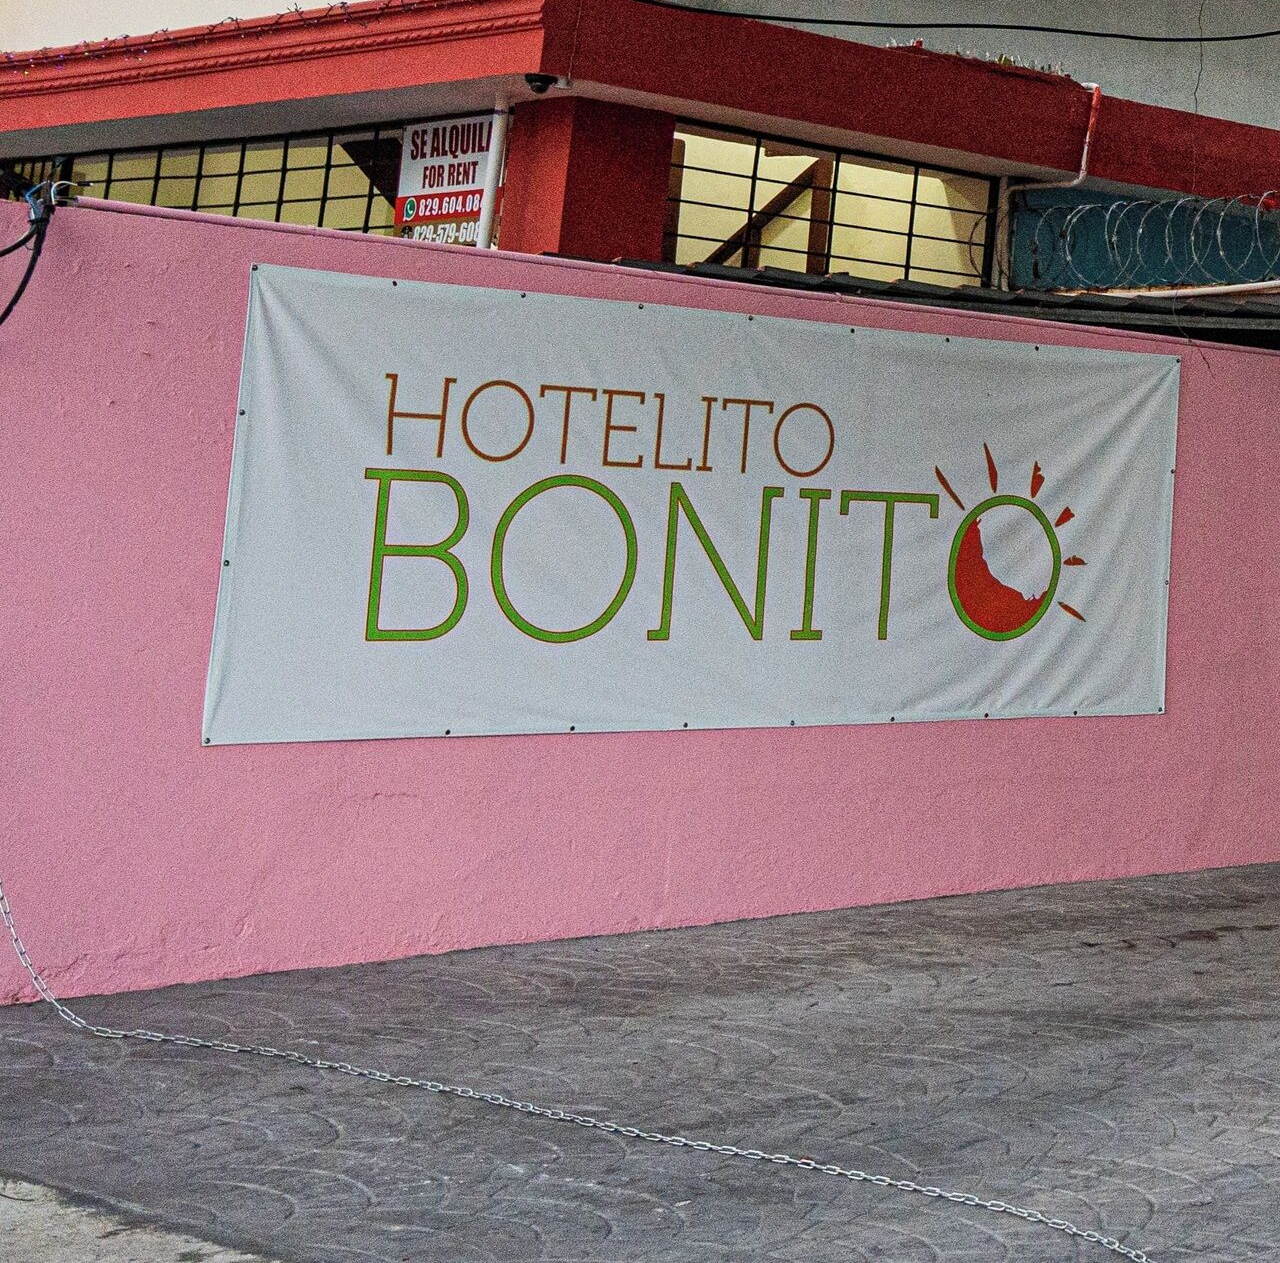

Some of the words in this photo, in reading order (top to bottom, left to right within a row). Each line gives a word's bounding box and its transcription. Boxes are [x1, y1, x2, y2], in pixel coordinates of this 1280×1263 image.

[411, 129, 428, 160] SE
[423, 165, 444, 189] FOR
[448, 161, 478, 186] RENT
[420, 195, 483, 216] 829.604.08
[387, 373, 834, 477] HOTELITO
[364, 468, 1062, 642] BONITO
